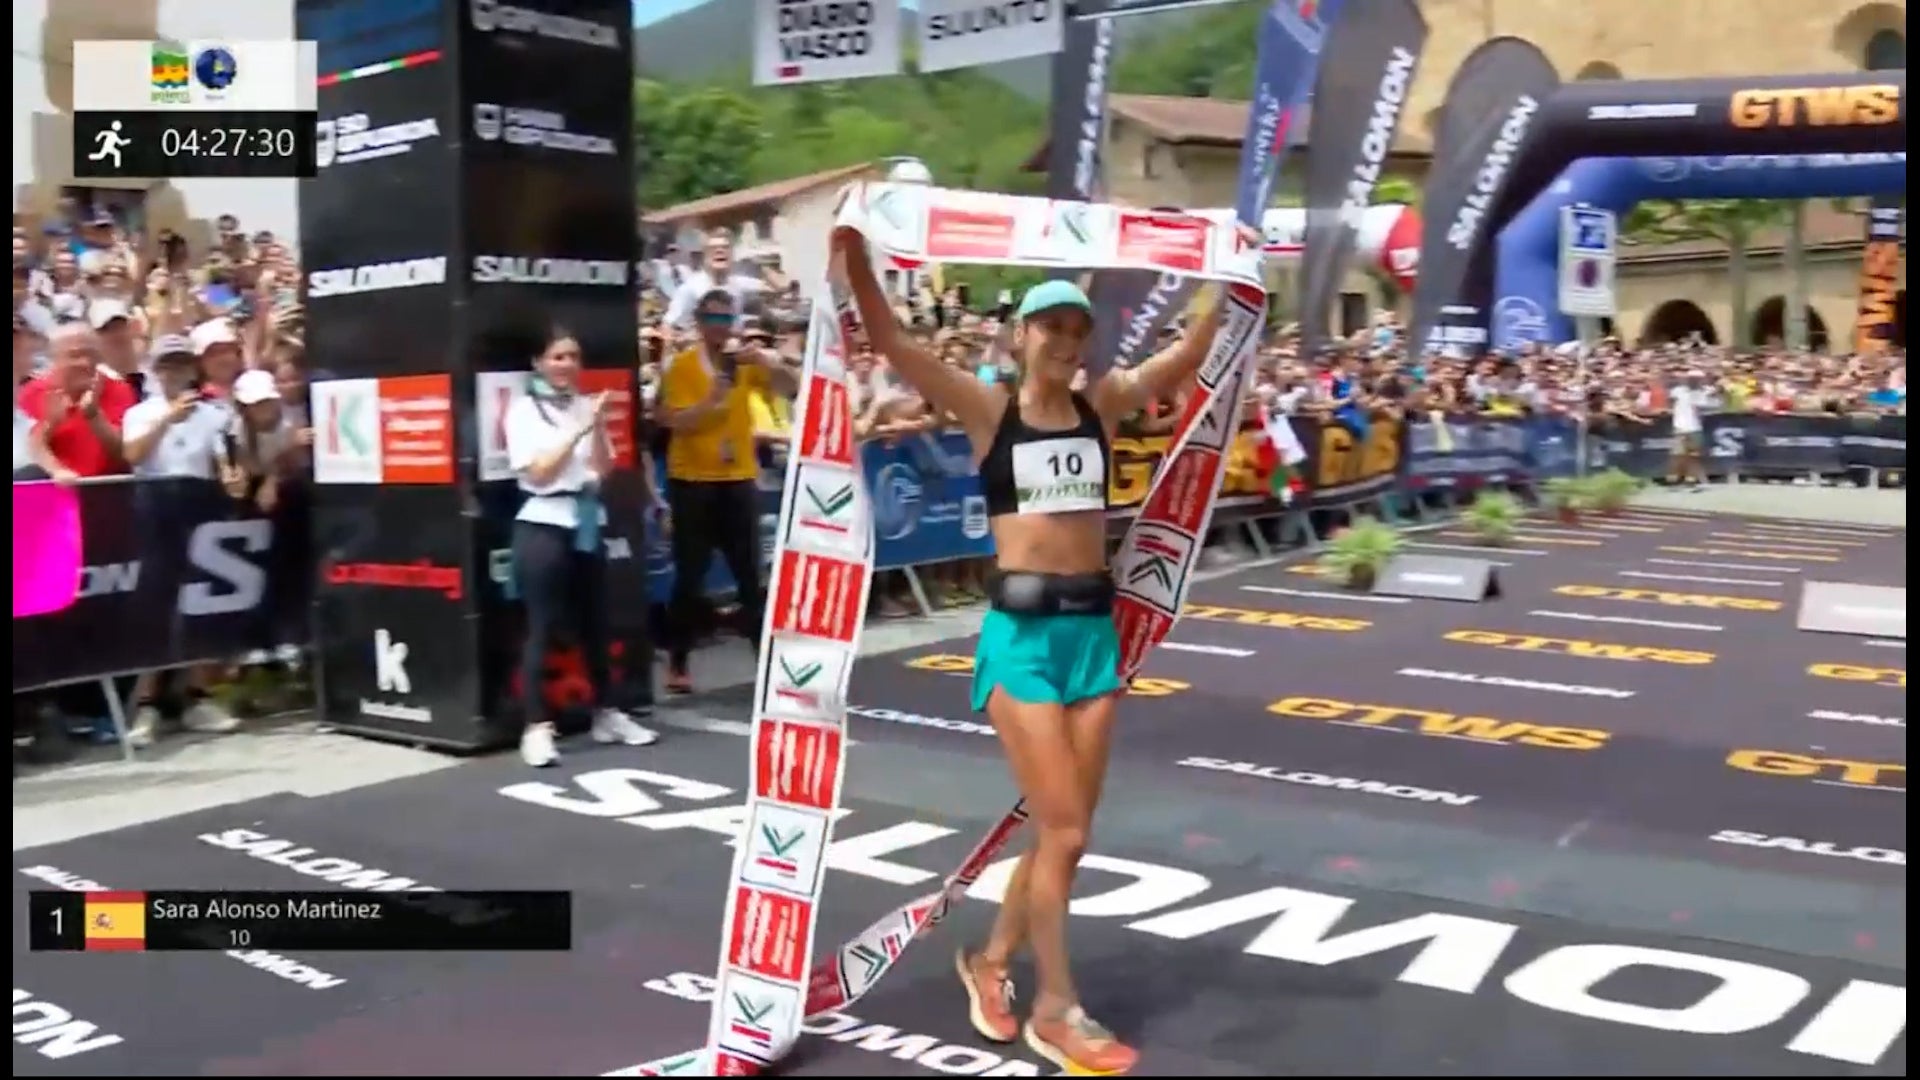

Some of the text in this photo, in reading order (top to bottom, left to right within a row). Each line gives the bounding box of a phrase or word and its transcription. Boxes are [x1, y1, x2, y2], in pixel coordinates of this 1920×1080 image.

[929, 0, 1050, 40] SUUNTO
[779, 30, 870, 58] VASCO
[1730, 84, 1900, 128] GTWS
[1048, 452, 1083, 476] 10
[177, 519, 273, 615] S
[1266, 697, 1612, 749] GTWS
[1176, 756, 1480, 805] SALOMON
[1725, 749, 1906, 784] GT
